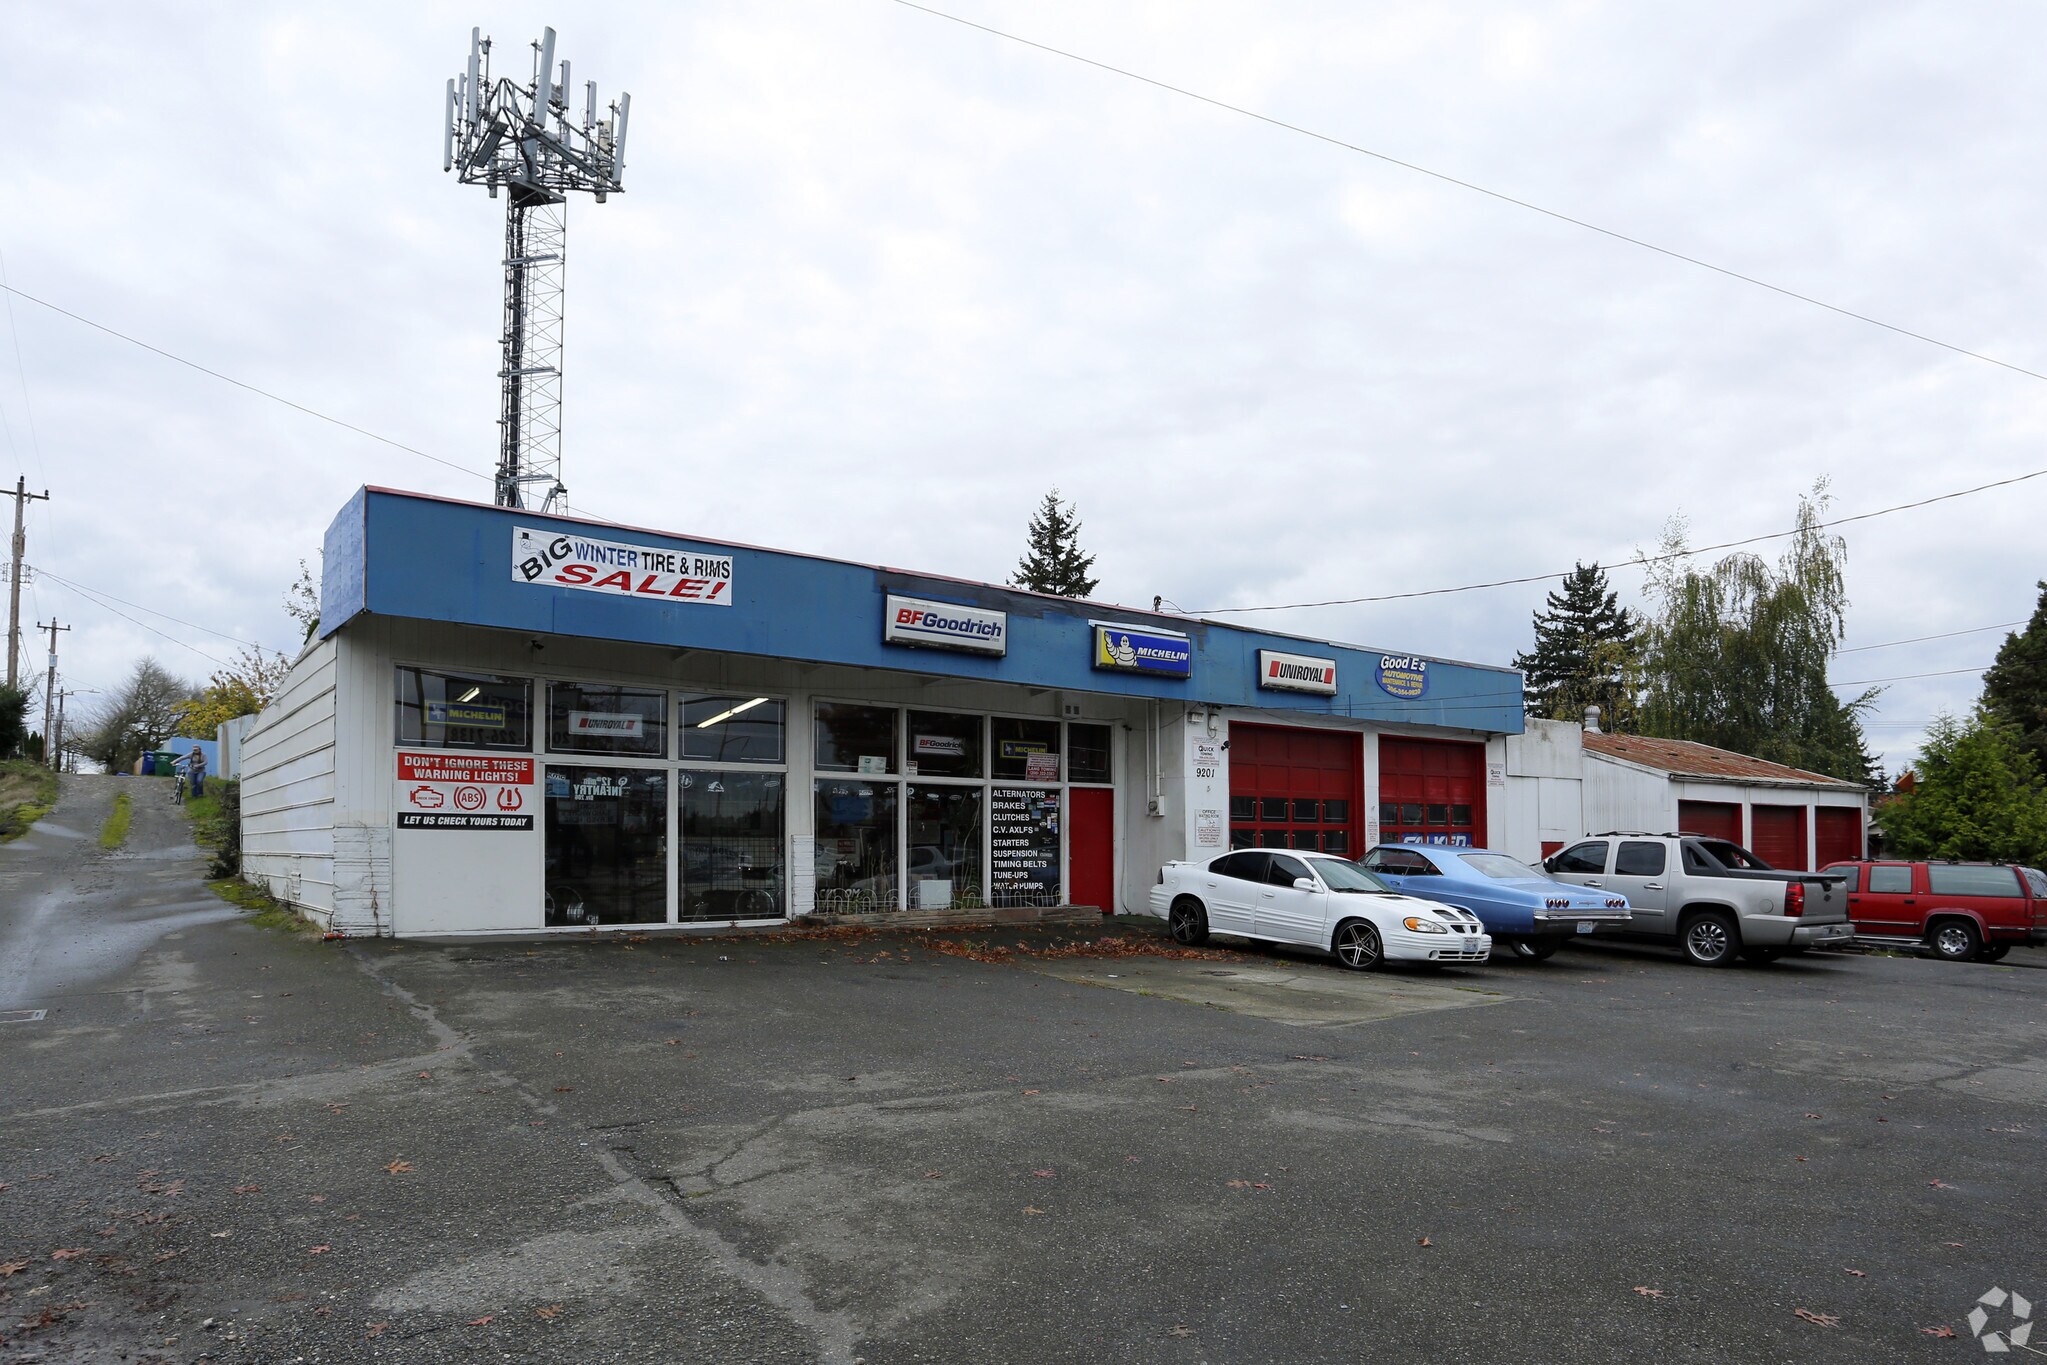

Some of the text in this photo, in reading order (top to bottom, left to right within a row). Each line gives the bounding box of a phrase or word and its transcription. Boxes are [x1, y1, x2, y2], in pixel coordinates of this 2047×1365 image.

[575, 542, 638, 568] WINTER
[641, 551, 676, 573] TIRE
[679, 558, 690, 575] &
[694, 560, 731, 579] RIMS
[554, 564, 728, 600] SALE!
[896, 608, 1002, 637] BFGoodrich
[1137, 647, 1189, 661] MICHELIN
[1380, 655, 1410, 670] Good
[1279, 662, 1325, 683] UNIROYAL
[1382, 670, 1424, 682] AUTOMOTIVE
[448, 709, 503, 720] MICHELIN
[587, 719, 627, 730] UNIROYAL
[919, 739, 964, 748] BFGoodrich
[404, 756, 528, 771] DON'T IGNORE THESE
[414, 768, 519, 782] WARNING LIGHTS!
[1196, 767, 1215, 778] 9201
[461, 792, 479, 803] ABS
[992, 789, 1046, 799] ALTERNATORS
[992, 801, 1026, 810] BRAKES
[404, 816, 528, 827] LET US CHECK YOURS TODAY
[992, 813, 1030, 821] CLUTCHES
[992, 826, 1008, 834] C.V.
[992, 838, 1030, 847] STARTERS
[992, 849, 1038, 858] SUSPENSION
[993, 860, 1047, 868] TIMING BELTS
[993, 871, 1029, 879] TUNE-UPS
[1019, 882, 1044, 890] PUMPS
